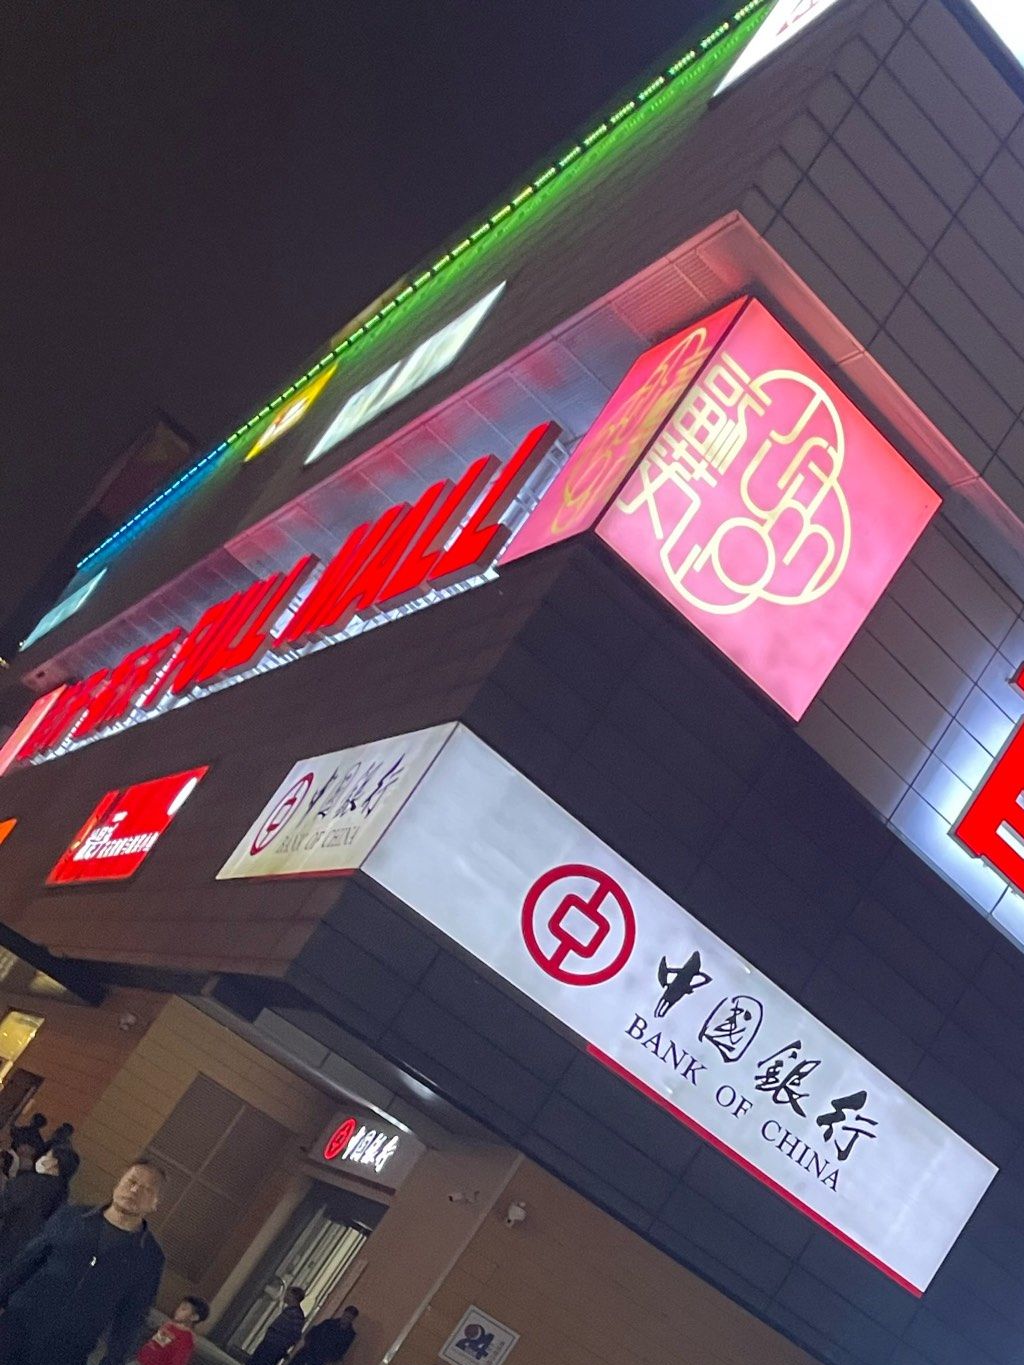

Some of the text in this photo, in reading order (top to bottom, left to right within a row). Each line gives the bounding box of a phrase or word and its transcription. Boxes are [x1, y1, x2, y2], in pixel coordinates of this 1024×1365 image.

[272, 419, 558, 648] MALL
[624, 1013, 842, 1193] BANK OF CHINA
